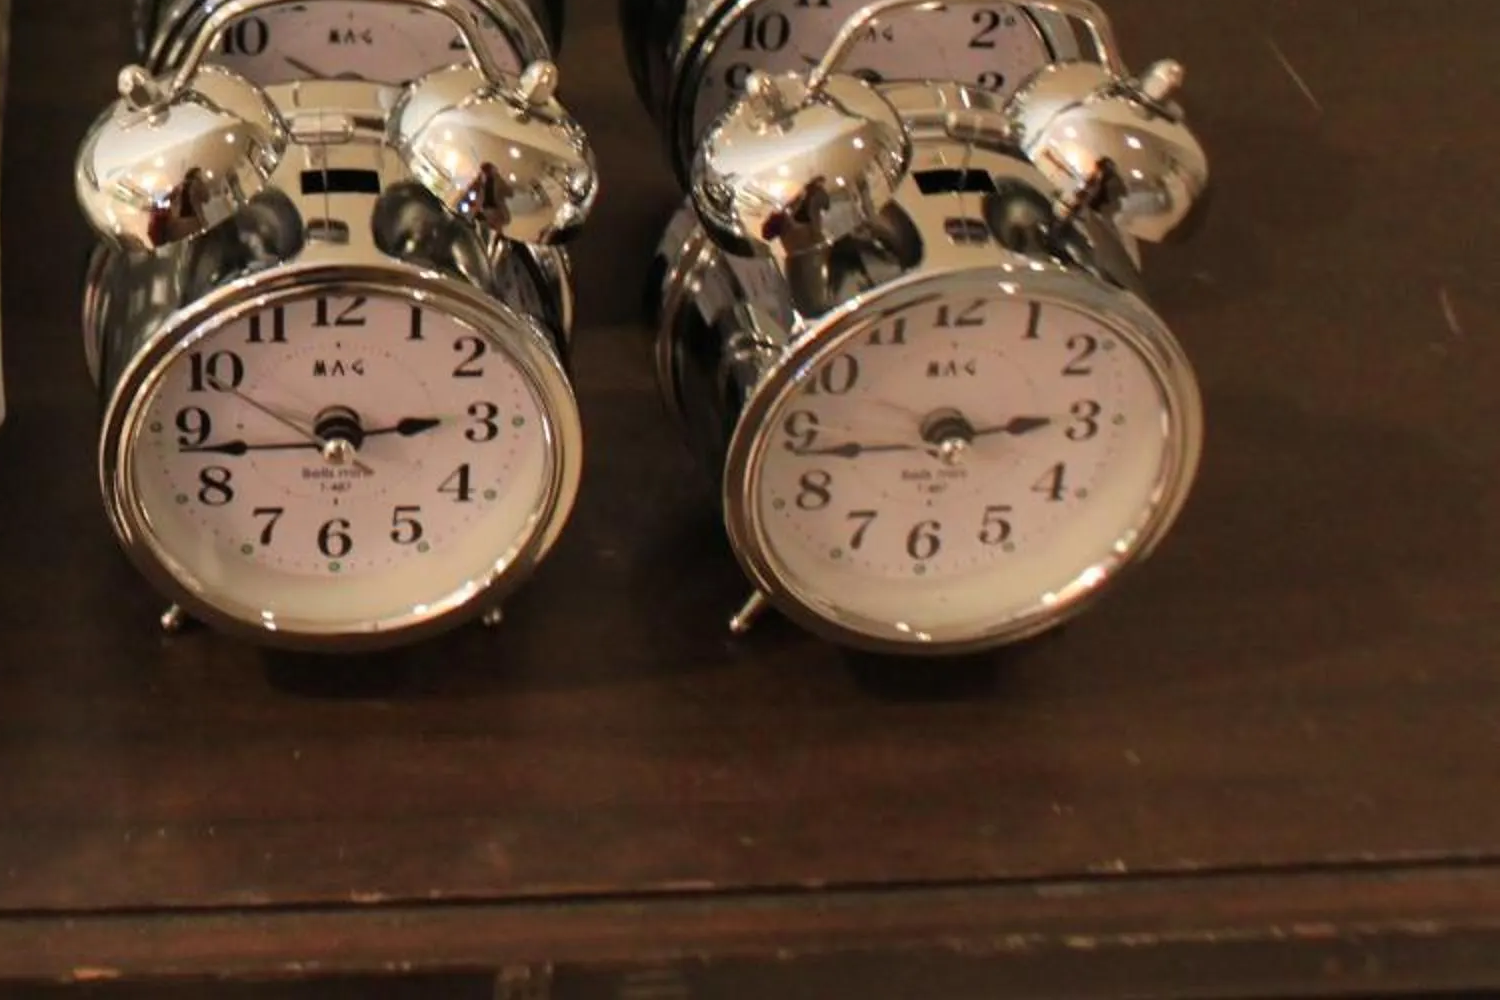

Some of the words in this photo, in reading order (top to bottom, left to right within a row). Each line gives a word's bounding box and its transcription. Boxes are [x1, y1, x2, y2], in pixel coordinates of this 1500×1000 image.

[221, 15, 269, 56] 10
[739, 13, 790, 51] 10
[968, 9, 1000, 49] 2
[245, 306, 288, 343] 11
[311, 296, 367, 327] 12
[405, 306, 426, 340] 1
[932, 299, 986, 327] 12
[1020, 300, 1041, 339] 1
[189, 351, 244, 392] 10
[312, 359, 365, 377] MAG
[452, 337, 486, 377] 2
[1061, 335, 1096, 376] 2
[175, 407, 212, 447] 9
[465, 402, 498, 442] 3
[784, 410, 819, 452] 9
[1064, 400, 1100, 441] 3
[199, 466, 234, 505] 8
[437, 464, 475, 501] 4
[796, 469, 833, 511] 8
[1031, 462, 1068, 501] 4
[253, 508, 283, 545] 7
[317, 518, 352, 558] 6
[391, 506, 423, 545] 5
[846, 511, 878, 551] 7
[906, 521, 941, 561] 6
[978, 506, 1012, 545] 5
